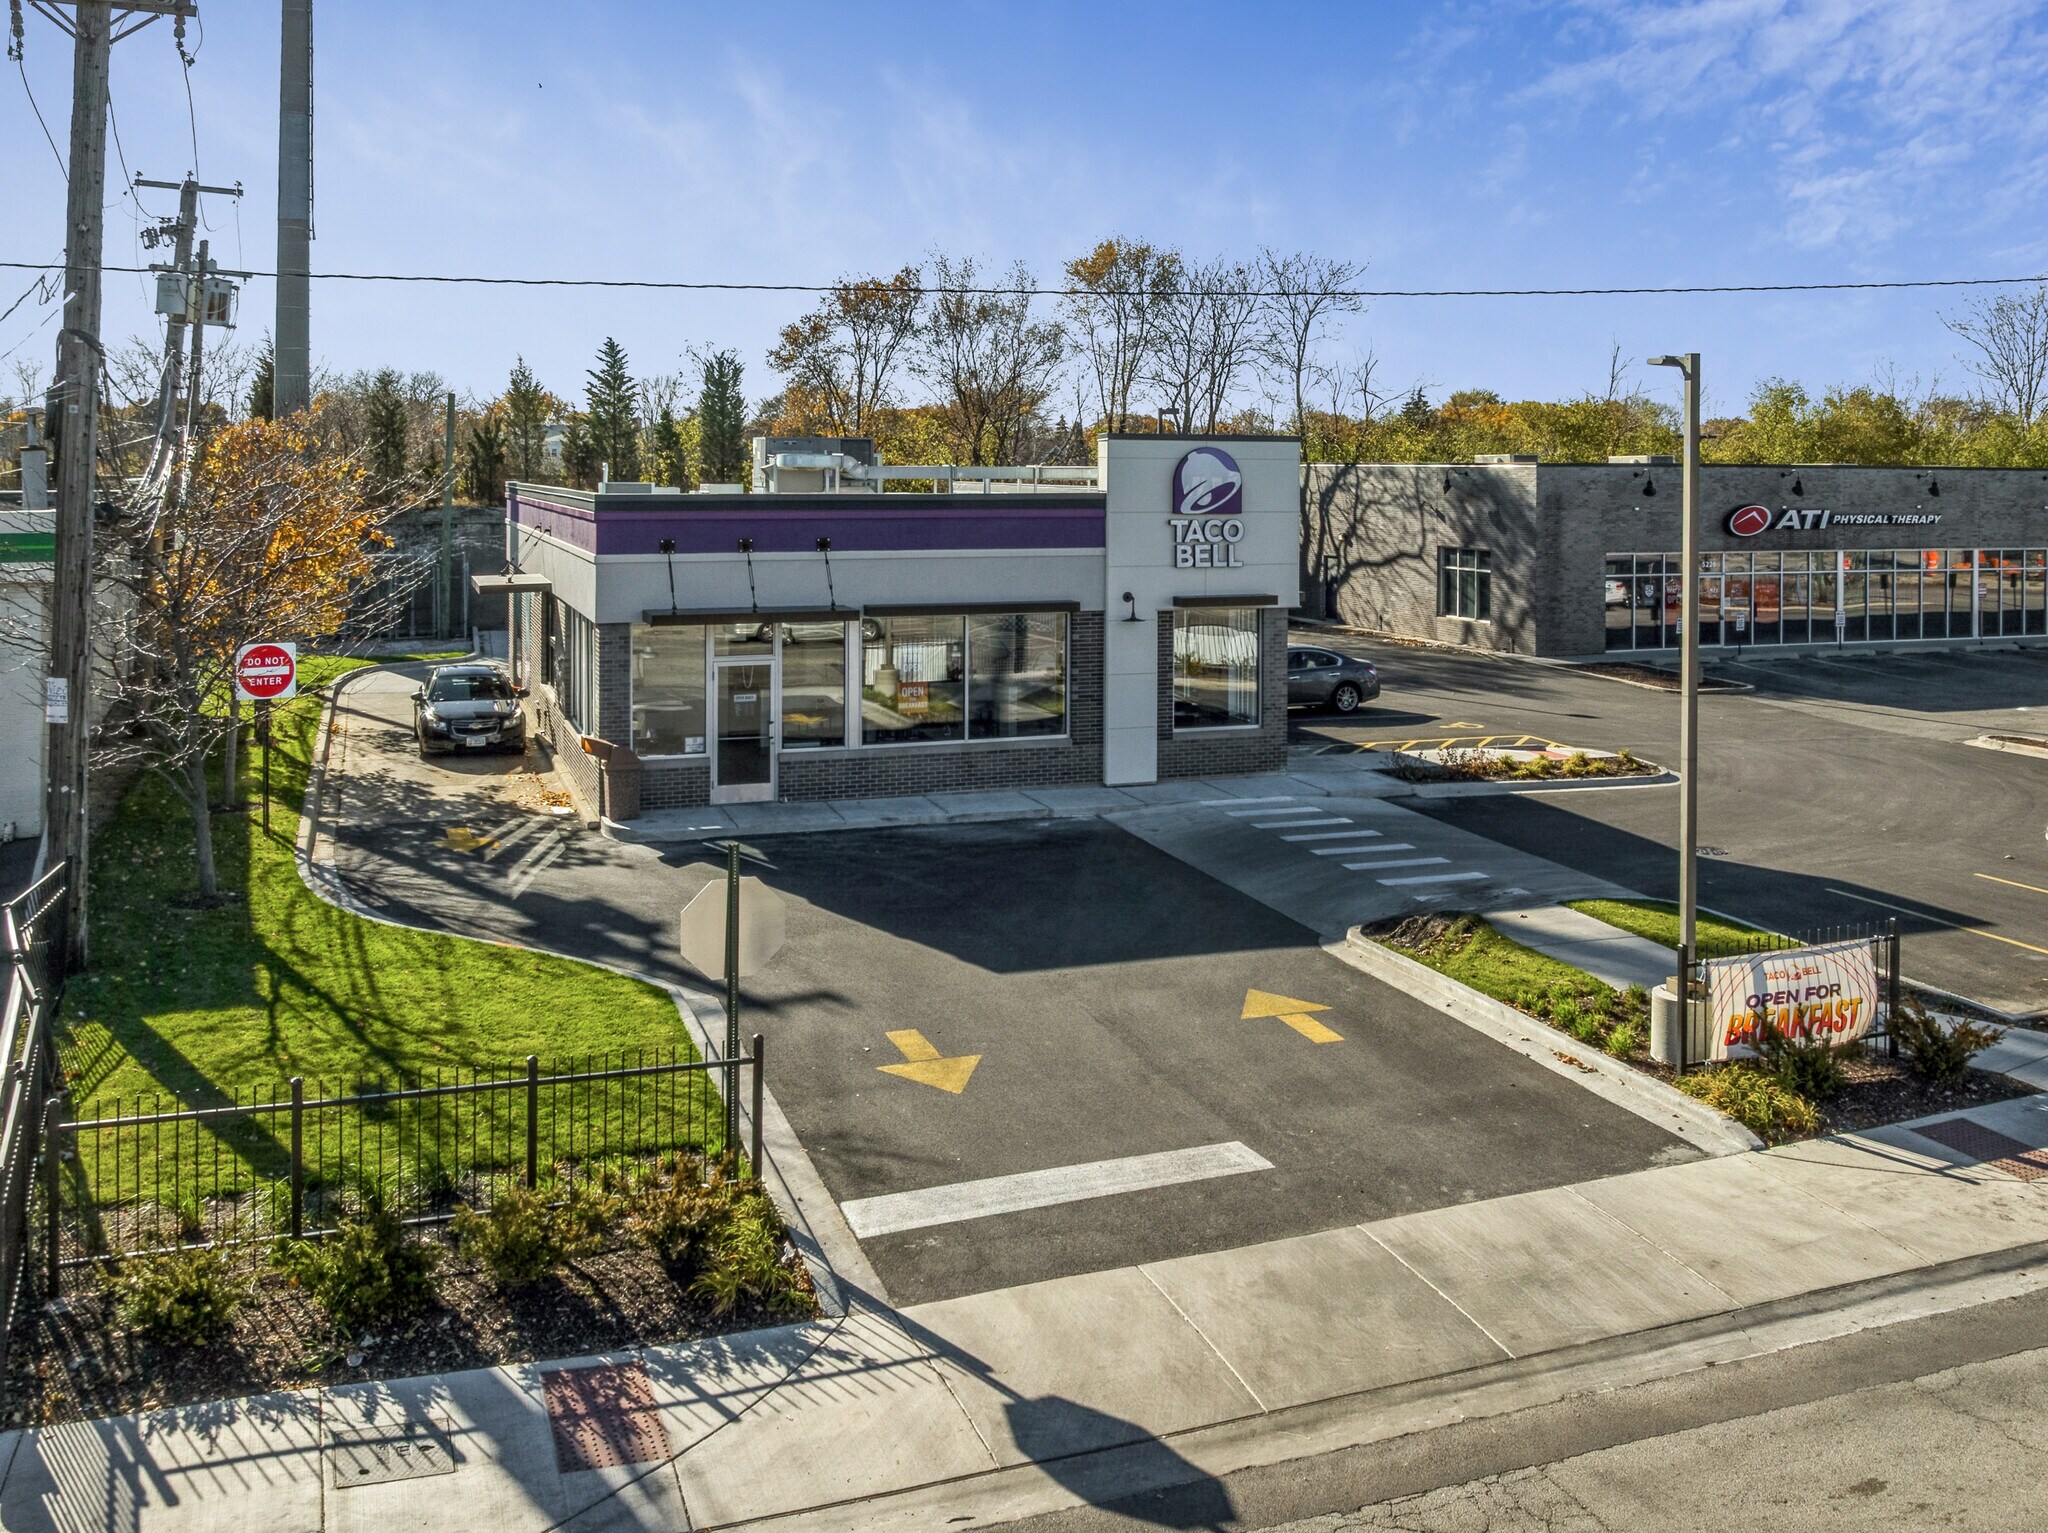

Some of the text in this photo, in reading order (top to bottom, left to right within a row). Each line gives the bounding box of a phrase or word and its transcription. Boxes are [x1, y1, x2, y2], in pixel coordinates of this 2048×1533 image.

[1775, 510, 1942, 529] ATI PHYSICAL THERAPY
[1168, 519, 1245, 543] TACO
[1175, 544, 1244, 568] BELL
[247, 656, 285, 666] DO NOT
[250, 676, 282, 686] ENTER
[902, 687, 924, 697] OPEN
[1764, 966, 1822, 980] TACO BELL
[1746, 983, 1841, 1009] OPEN FOR
[1724, 997, 1863, 1046] BREAKFAST
